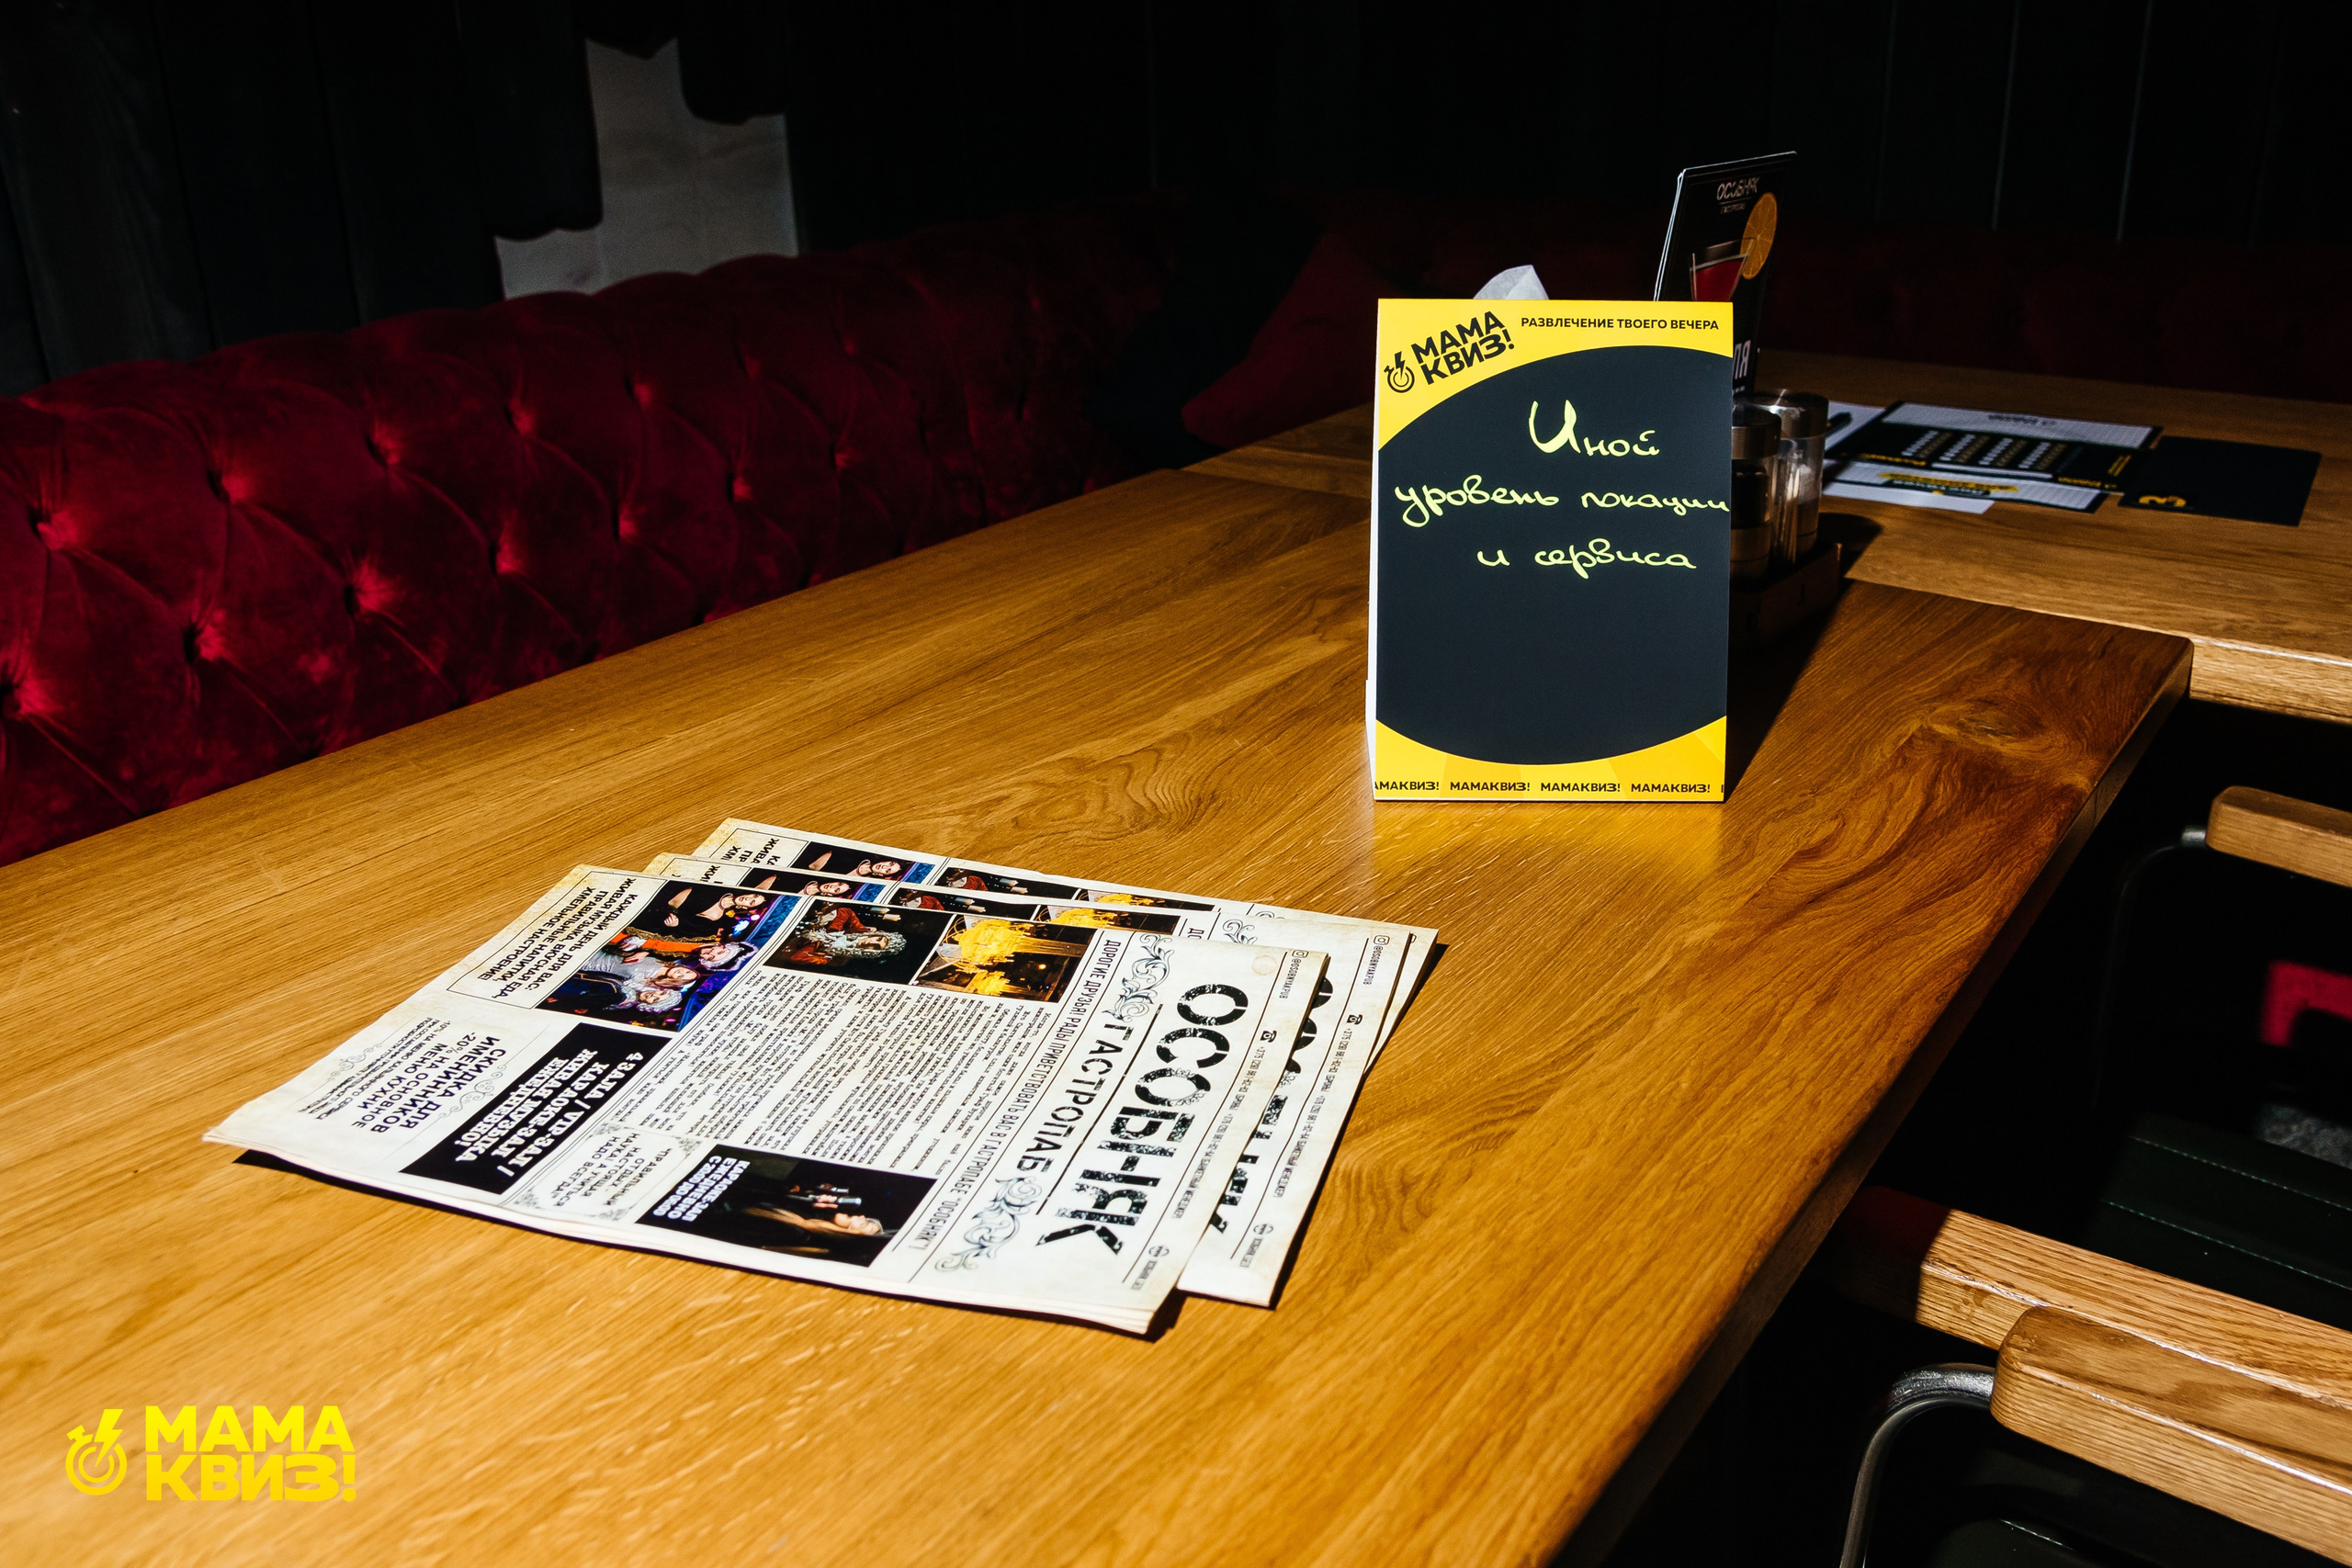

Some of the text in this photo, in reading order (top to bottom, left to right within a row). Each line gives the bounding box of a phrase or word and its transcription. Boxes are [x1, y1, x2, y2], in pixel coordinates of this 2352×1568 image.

[1411, 310, 1506, 364] МАМА
[1521, 317, 1720, 330] РАЗВЛЕЧЕНИЕ ТВОЕГО ВЕЧЕРА
[1420, 329, 1515, 385] КВИЗ!
[1529, 400, 1660, 457] Иной
[1395, 474, 1560, 528] уровень
[1476, 538, 1697, 580] и сервиса
[1450, 781, 1531, 792] МАМАКВИЗ!
[1540, 782, 1621, 793] МАМАКВИЗ!
[1631, 783, 1711, 794] МАМАКВИЗ!
[750, 838, 780, 864] ЖИВА
[478, 887, 595, 980] ХМЕЛЬНОЕ НАСТРОЕНИЕ!
[492, 891, 608, 981] ПРАВИЛЬНЫЕ НАПИТКИ,
[492, 878, 636, 998] ЖИВАЯ МУЗЫКА, ВКУСНАЯ ЕДА,
[525, 895, 638, 990] КАЖДЫЙ ДЕНЬ ДЛЯ ВАС:
[1090, 940, 1121, 979] ДОРОГИЕ
[1069, 980, 1101, 1015] ДРУЗЬЯ!
[1279, 959, 1301, 998] @OSOBNYAKPUB
[401, 1043, 425, 1060] МЕНЮ
[1055, 1018, 1081, 1042] РАДЫ
[352, 1032, 476, 1128] -20% НА ОСНОВНОЕ
[357, 1043, 447, 1109] МЕНЮ КУХНИ
[371, 1036, 500, 1133] ИМЕНИННИКОВ
[400, 1049, 506, 1128] СКИДКА ДЛЯ
[455, 1057, 569, 1148] ЕЖЕДНЕВНО!
[584, 1062, 636, 1099] ЗАЛА
[1008, 1043, 1066, 1111] ПРИВЕТСТВОВАТЬ
[1017, 1024, 1134, 1172] ГАСТРОПАБ
[456, 1049, 597, 1161] ЖИВАЯ МУЗЫКА
[492, 1062, 609, 1157] КАРАОКЕ-ЗАЛ
[996, 1115, 1019, 1130] ВАС
[1036, 984, 1248, 1255] ОСОБНЯК
[508, 1111, 584, 1167] VIP-ЗАЛ
[592, 1136, 619, 1158] НАДО
[606, 1134, 639, 1160] НАУКА!
[555, 1172, 599, 1206] УЧИТЬСЯ
[582, 1147, 640, 1196] НАСТОЯЩАЯ
[611, 1158, 644, 1187] ОТДЫХ
[668, 1157, 737, 1218] ЕЖЕДНЕВНО
[676, 1182, 695, 1195] ДО
[682, 1161, 750, 1222] КАРАОКЕ-ЗАЛ
[950, 1140, 1001, 1194] ГАСТРОПАБЕ
